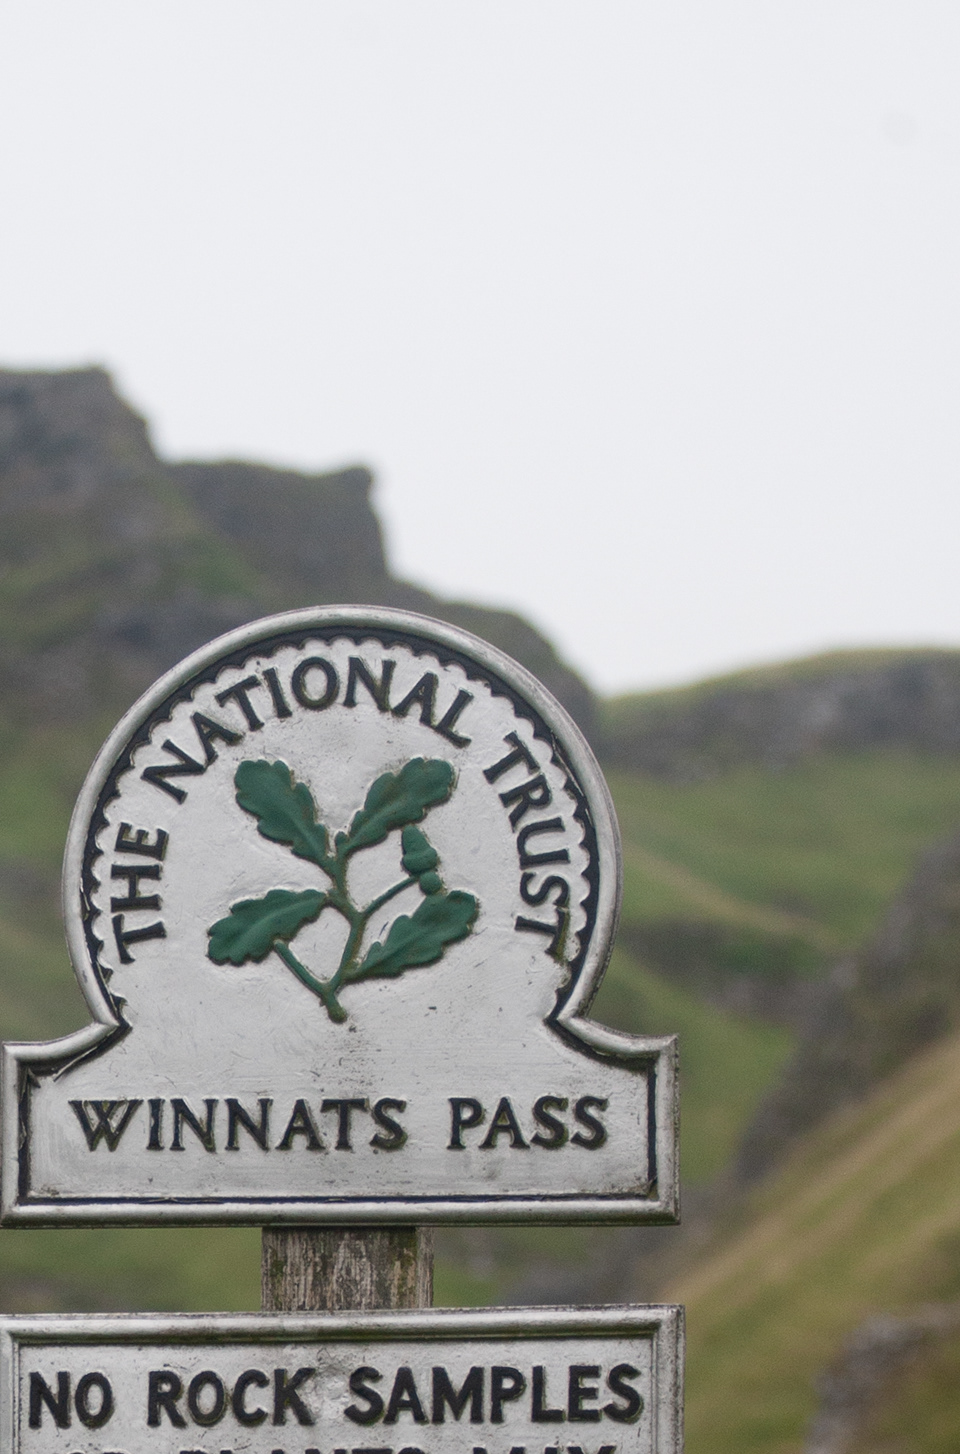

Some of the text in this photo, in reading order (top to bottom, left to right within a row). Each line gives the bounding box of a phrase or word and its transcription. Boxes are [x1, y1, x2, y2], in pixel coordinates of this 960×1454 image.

[109, 655, 571, 965] THE NATIONAL TRUST
[68, 1096, 609, 1152] WINNATS PASS
[28, 1362, 644, 1429] NO ROCK SAMPLES
